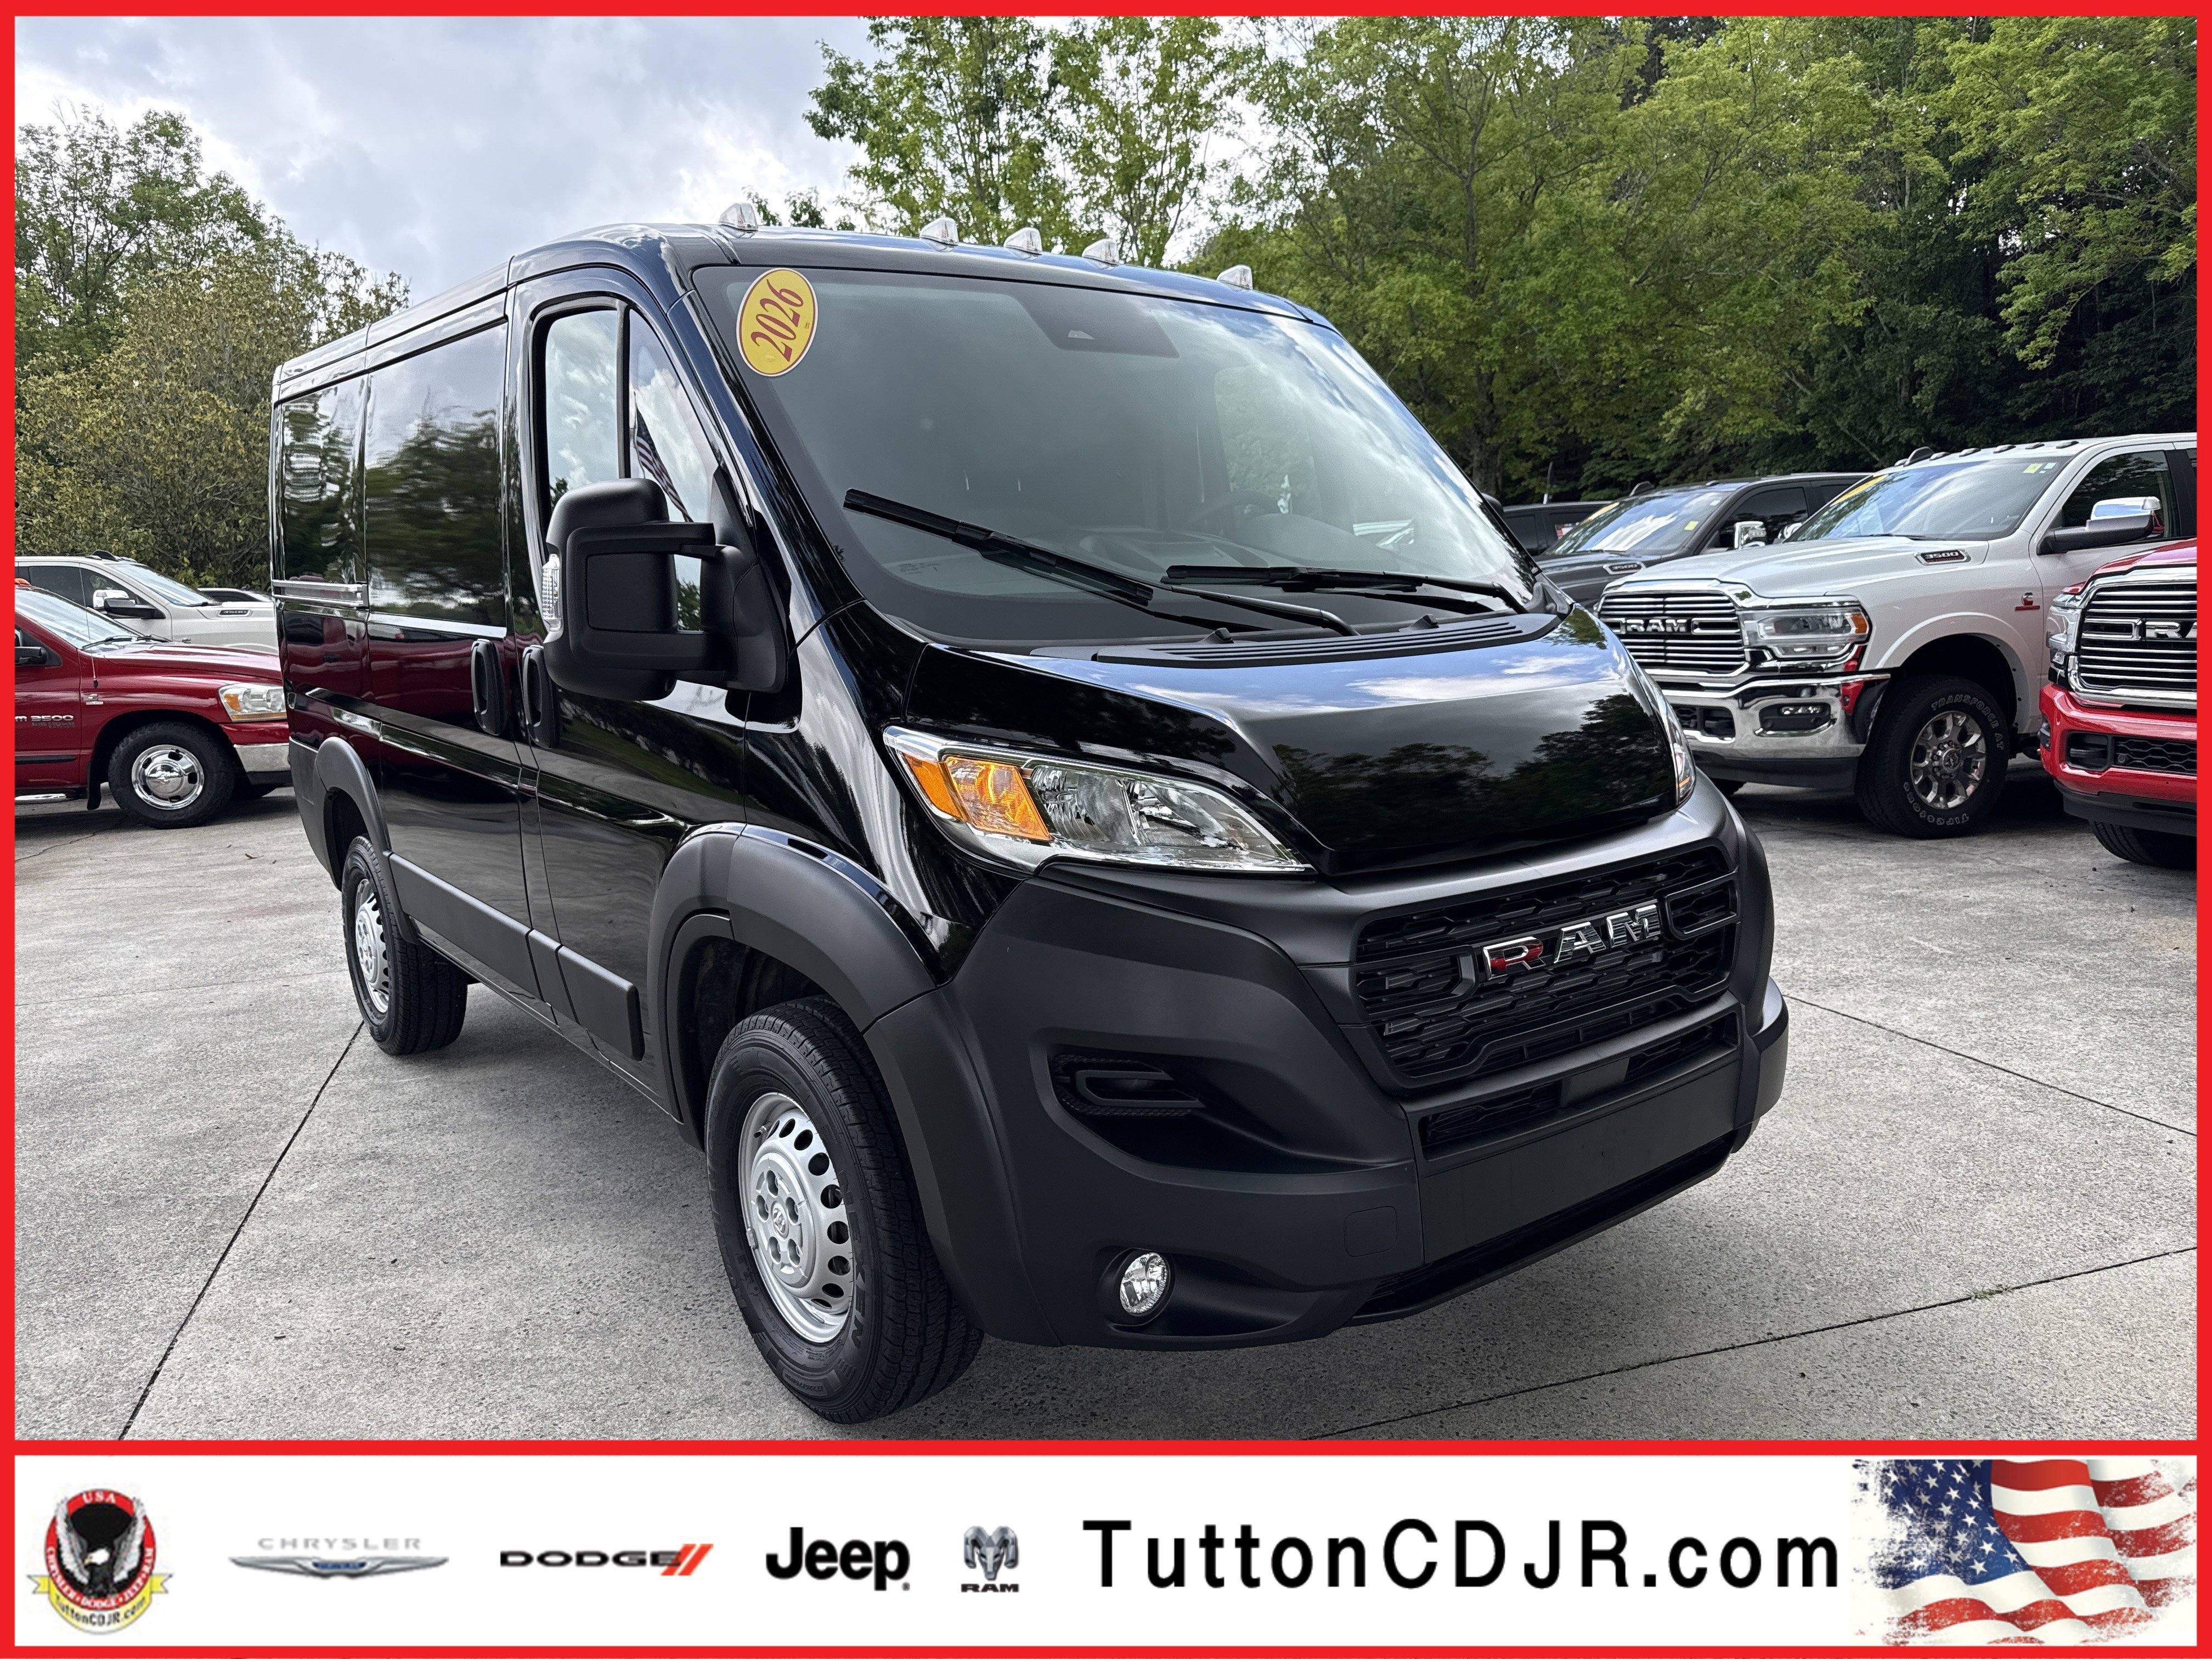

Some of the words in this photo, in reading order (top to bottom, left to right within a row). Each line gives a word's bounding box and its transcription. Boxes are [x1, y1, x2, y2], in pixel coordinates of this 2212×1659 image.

[751, 279, 804, 362] 2026
[1626, 619, 1687, 632] RAM
[1931, 694, 1999, 729] TRANSFORCE
[1483, 904, 1661, 981] RAM
